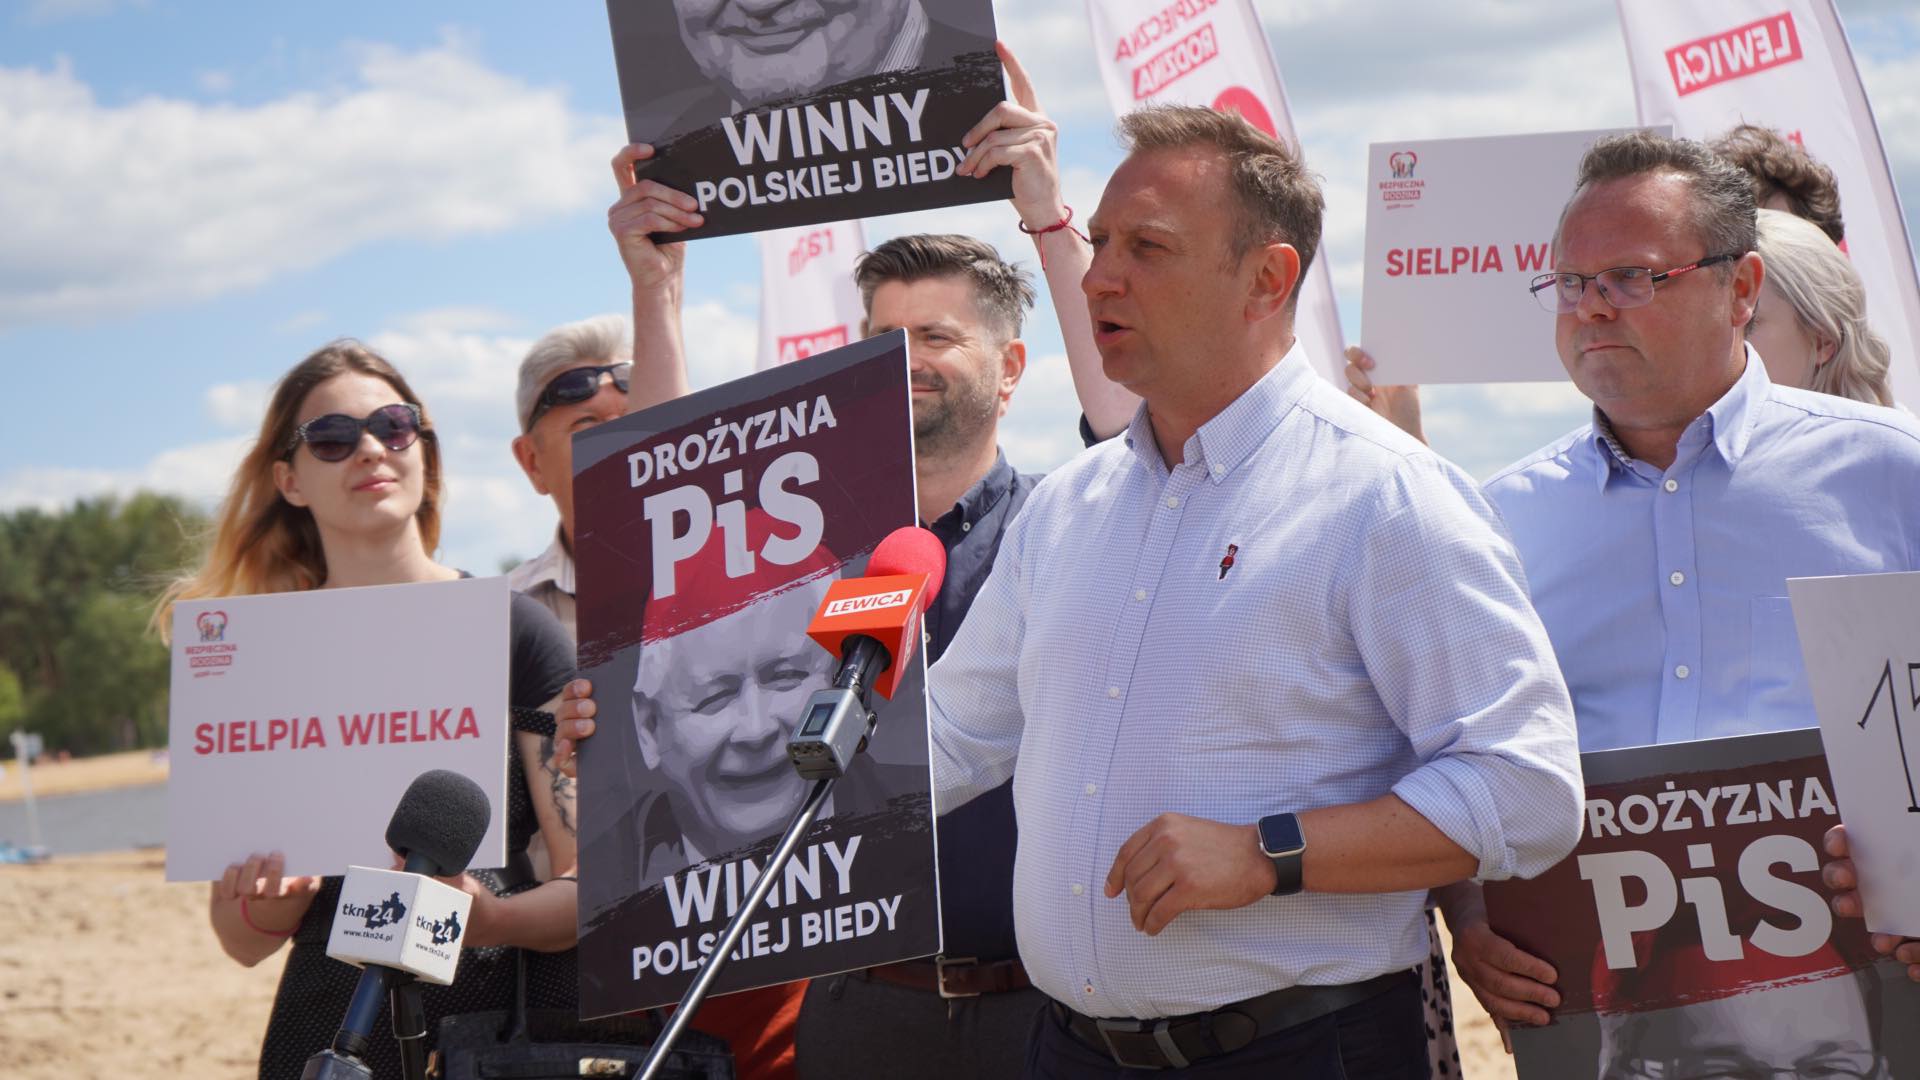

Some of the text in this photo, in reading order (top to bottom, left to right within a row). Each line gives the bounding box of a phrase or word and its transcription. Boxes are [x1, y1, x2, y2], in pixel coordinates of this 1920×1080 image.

[720, 88, 931, 166] WINNY
[695, 160, 862, 212] POLSKIEJ
[1386, 245, 1503, 277] SIELPIA
[628, 395, 837, 488] DROŻYZNA
[643, 452, 825, 600] PiS
[831, 592, 905, 614] LEWICA
[193, 706, 481, 755] SIELPIA WIELKA
[1584, 776, 1837, 839] ROŻYZNA
[664, 835, 862, 928] WINNY
[1577, 834, 1833, 969] PiS
[342, 903, 394, 924] tkn24
[343, 929, 394, 942] www.tkn24.pl
[416, 914, 453, 941] tkn24
[801, 894, 903, 948] BIEDY
